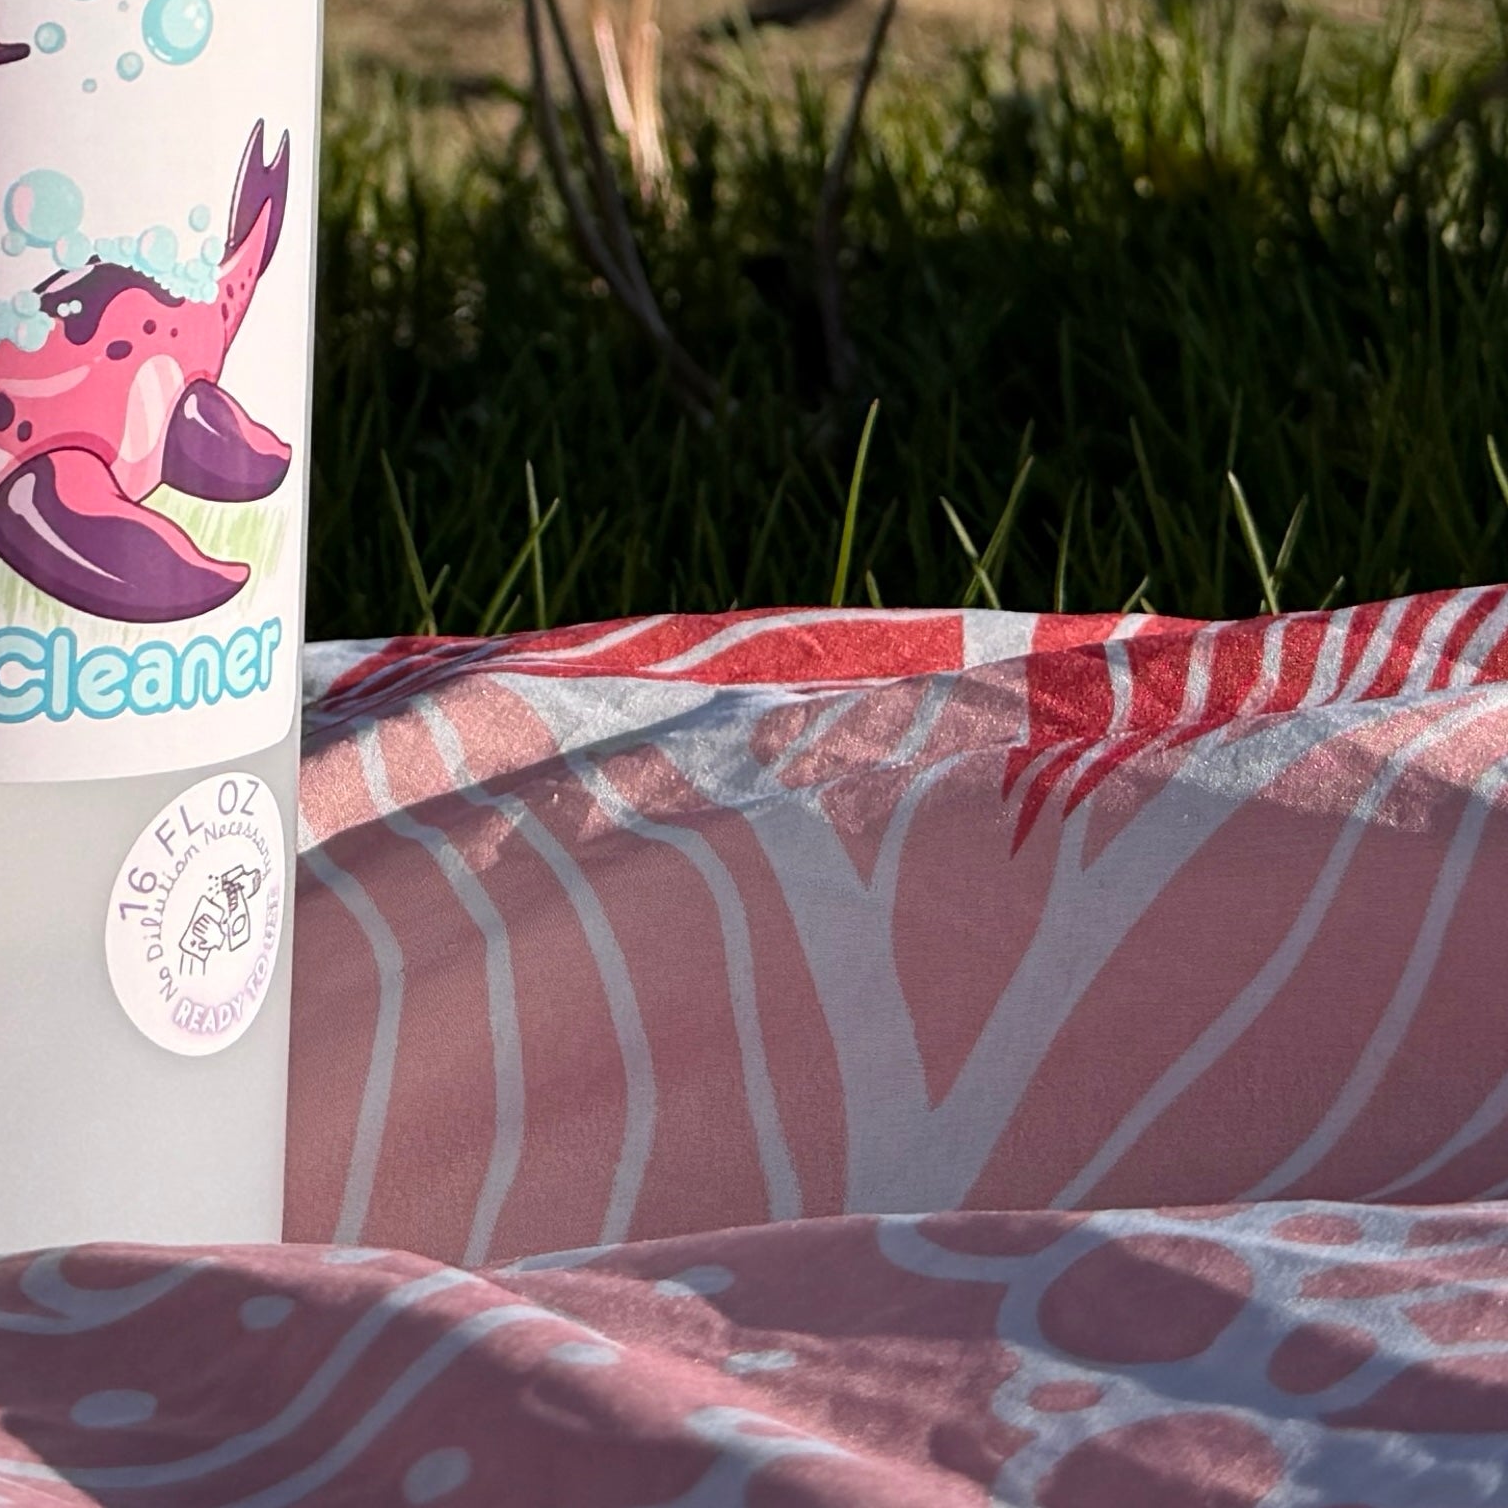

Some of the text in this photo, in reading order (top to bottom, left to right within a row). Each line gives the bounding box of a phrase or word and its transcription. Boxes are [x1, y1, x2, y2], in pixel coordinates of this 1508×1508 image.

[118, 779, 260, 921] 16 FL OZ
[141, 820, 272, 1003] No Dilution Necessary
[173, 994, 244, 1034] READY
[245, 955, 270, 1003] TO
